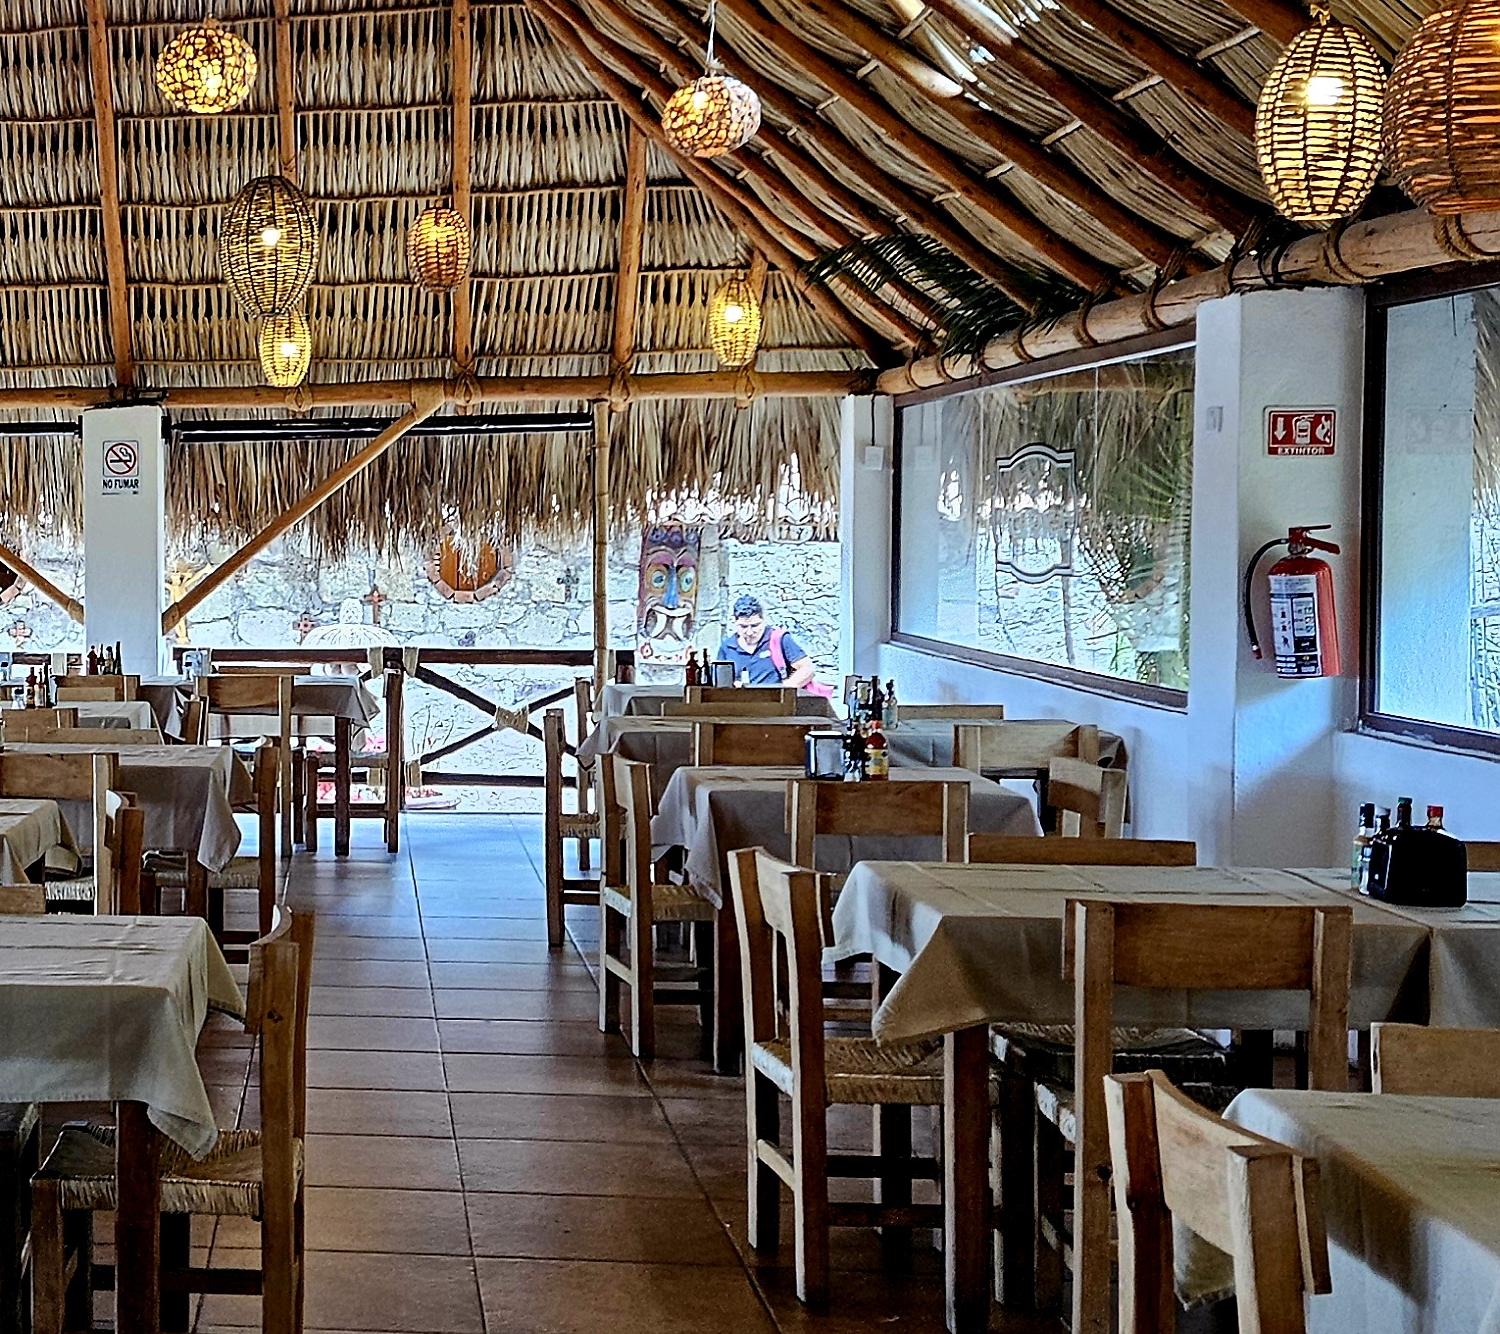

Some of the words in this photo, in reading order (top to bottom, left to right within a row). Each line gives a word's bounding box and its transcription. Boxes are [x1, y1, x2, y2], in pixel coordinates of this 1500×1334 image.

[1277, 447, 1325, 455] EXTINTOR
[102, 478, 113, 489] NO
[114, 478, 139, 489] FUMAR
